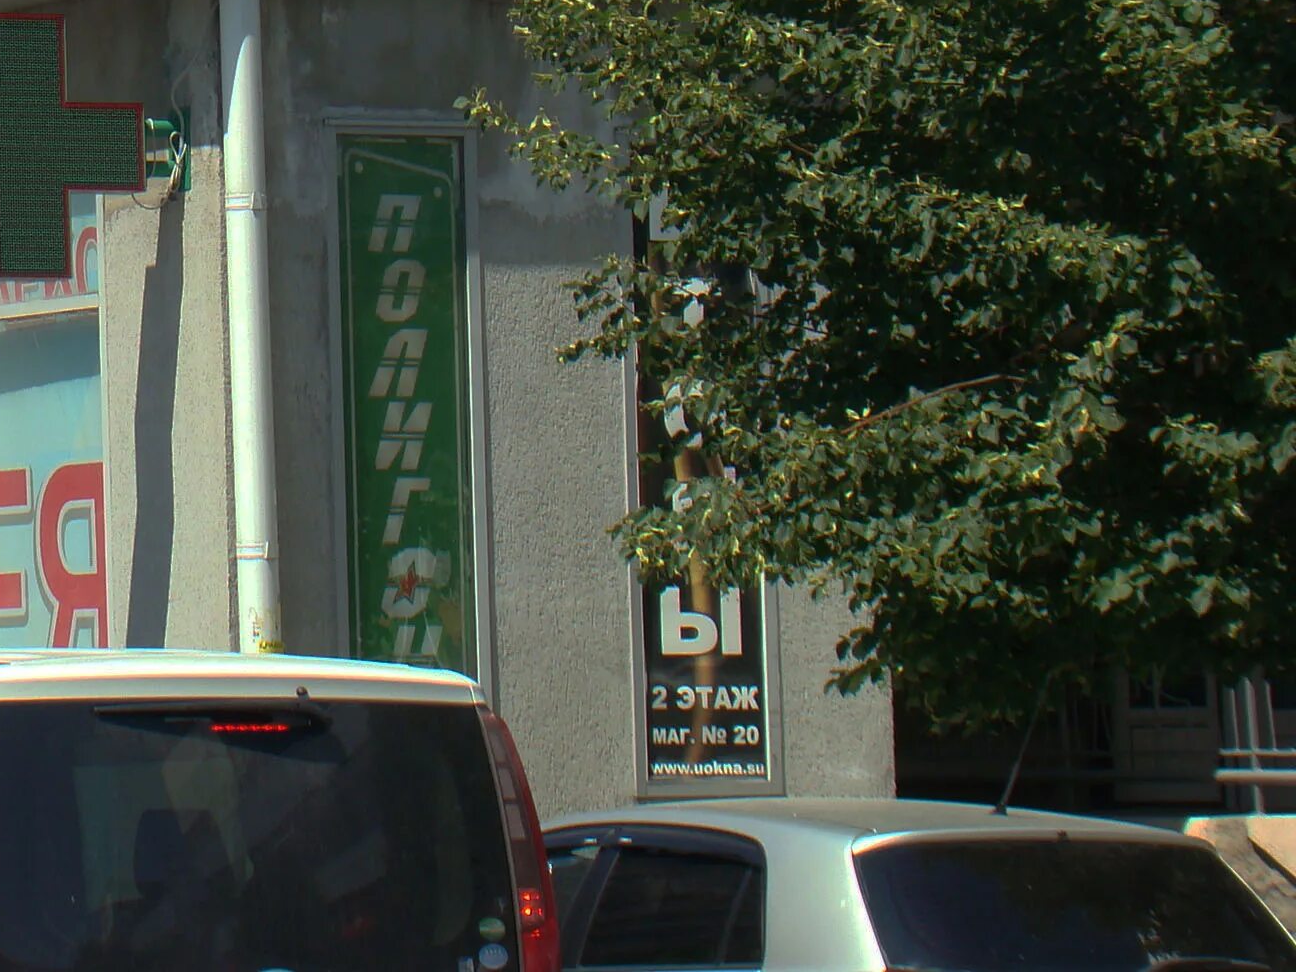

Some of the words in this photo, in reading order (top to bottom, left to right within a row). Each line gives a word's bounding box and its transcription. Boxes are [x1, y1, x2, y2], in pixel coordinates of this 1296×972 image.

[651, 684, 668, 711] 2
[675, 684, 760, 711] ЭТАЖ
[652, 727, 696, 745] МАГ.
[701, 724, 728, 745] №
[733, 724, 761, 746] 20
[651, 759, 766, 776] www.uokna.su
